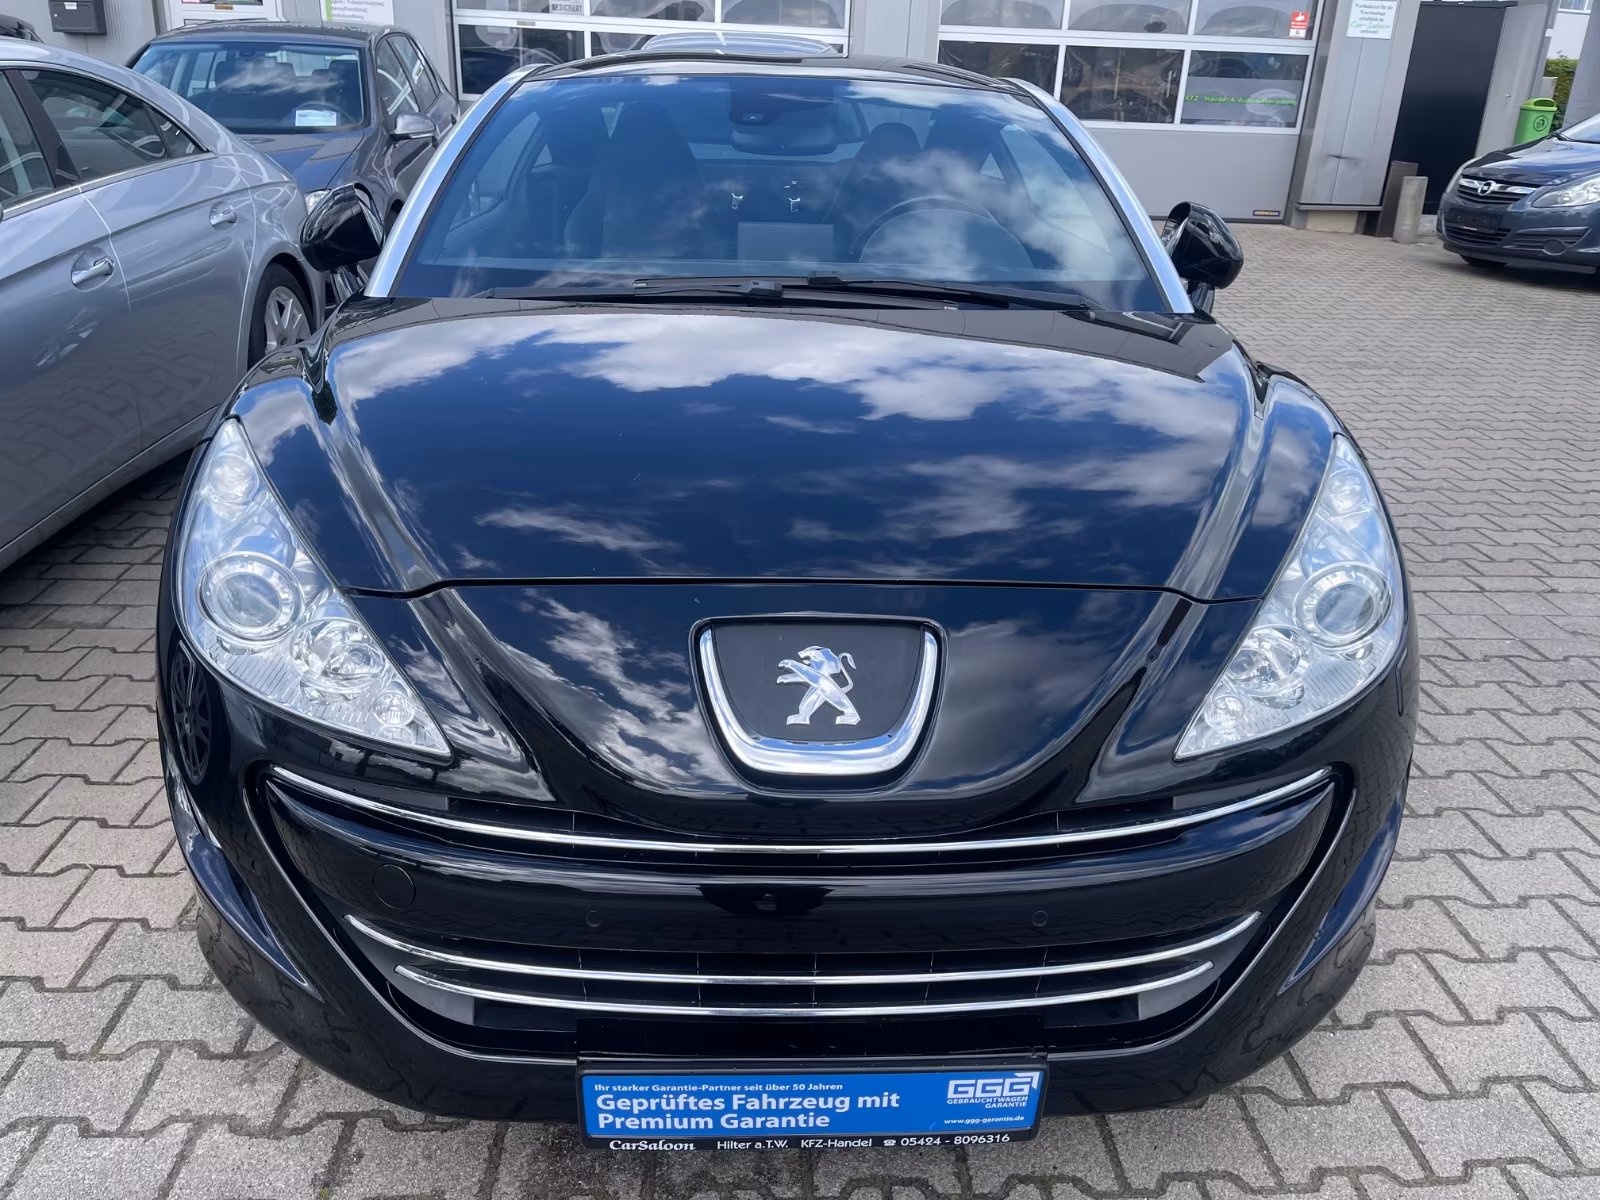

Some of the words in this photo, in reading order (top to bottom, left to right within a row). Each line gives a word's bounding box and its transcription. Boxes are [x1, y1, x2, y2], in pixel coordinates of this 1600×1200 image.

[551, 4, 582, 12] GESICHERT
[652, 1084, 742, 1092] Garantie-Partner
[766, 1083, 790, 1091] über
[947, 1077, 1032, 1098] GGG
[596, 1094, 726, 1114] Geprüftes
[732, 1094, 850, 1113] Fahrzeug
[857, 1092, 900, 1108] mit
[946, 1096, 1028, 1104] GEBRAUCHTWAGEN
[598, 1112, 714, 1129] Premium
[720, 1112, 830, 1129] Garantie
[944, 1116, 1025, 1125] www.ggg-garantie.de
[609, 1139, 696, 1151] CarSaloon
[716, 1140, 752, 1150] Hilter
[754, 1140, 788, 1149] a.T.W.
[800, 1138, 873, 1148] KFZ-Handel
[900, 1136, 942, 1146] 05424
[954, 1134, 1010, 1146] 8096316
